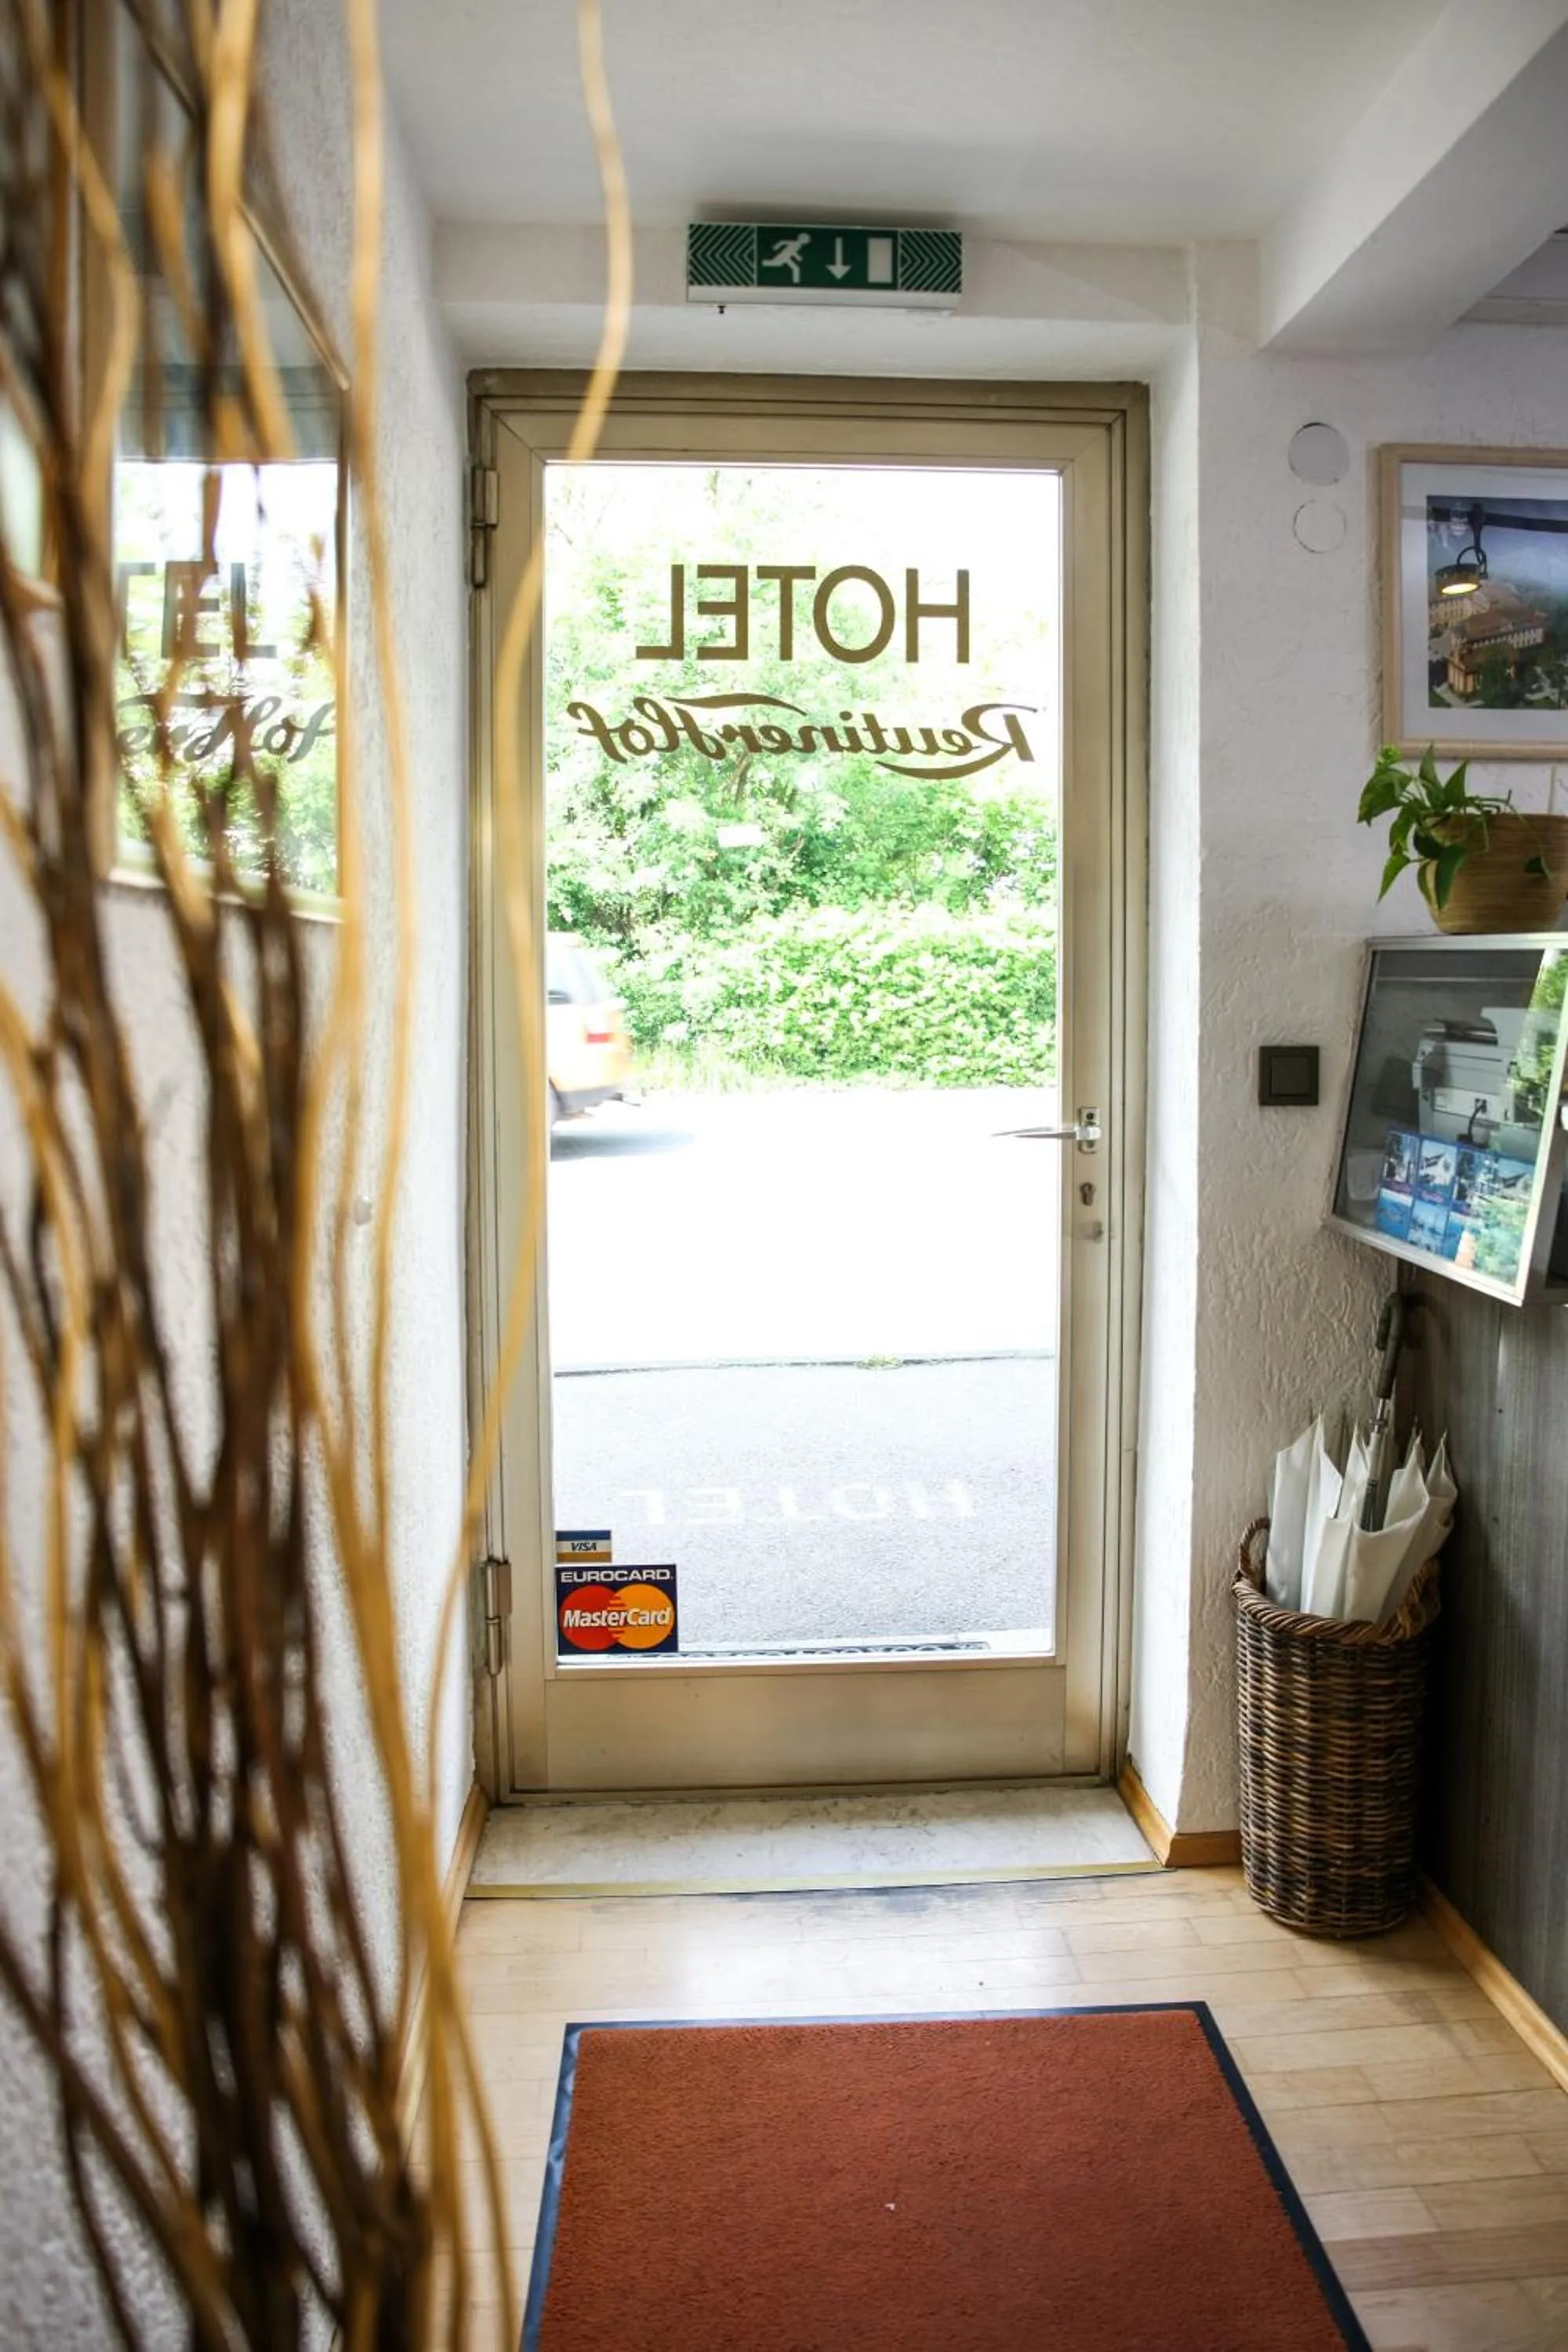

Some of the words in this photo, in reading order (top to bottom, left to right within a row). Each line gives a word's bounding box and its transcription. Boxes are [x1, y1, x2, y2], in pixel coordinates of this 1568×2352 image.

[571, 1541, 597, 1552] VISA
[561, 1569, 671, 1584] EUROCARD
[563, 1607, 672, 1628] MasterCard
